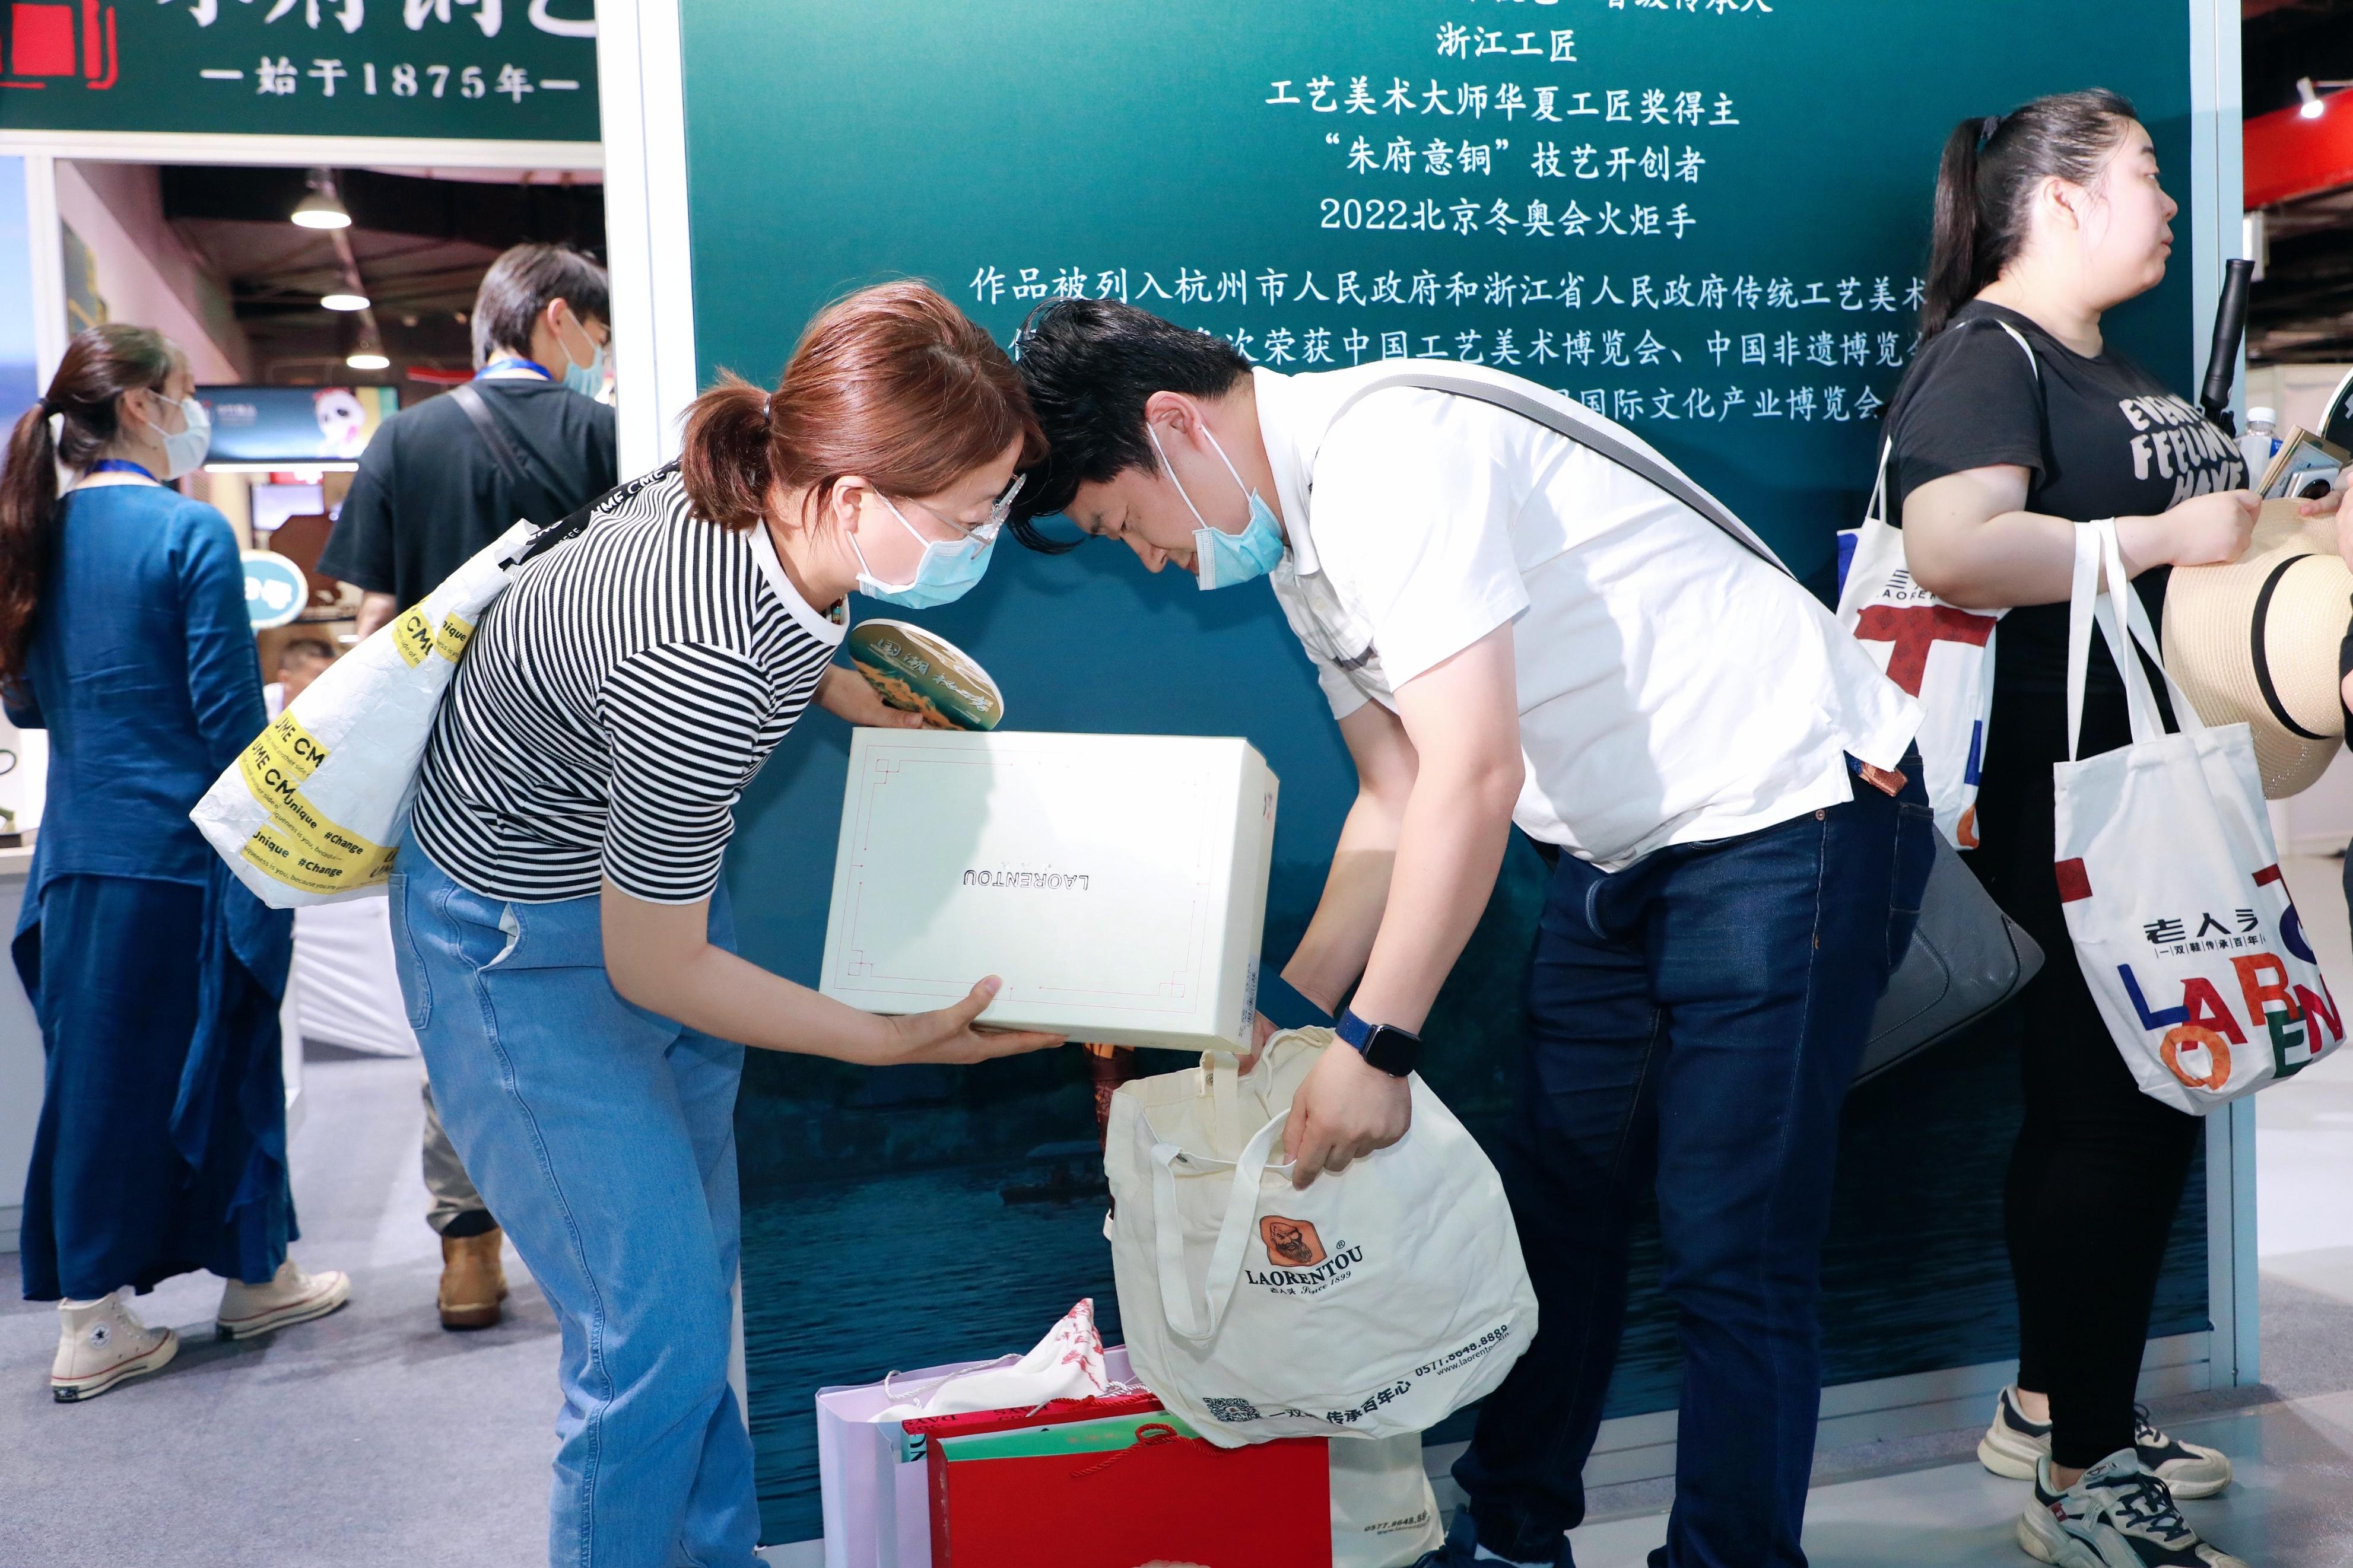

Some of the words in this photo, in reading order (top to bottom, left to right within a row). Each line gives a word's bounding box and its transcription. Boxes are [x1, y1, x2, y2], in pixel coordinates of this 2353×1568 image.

[1436, 21, 1577, 62] 浙江工匠
[1265, 75, 1740, 126] 工艺美术大师华夏工匠奖得主
[1320, 198, 1696, 239] 2022北京冬奥会火炬手
[969, 265, 1926, 312] 作品被列入杭州市人民政府和浙江省人民政府传统工艺美术
[1554, 385, 1884, 421] 国际文化产业博览会
[284, 794, 317, 829] Unique
[323, 831, 364, 855] #Change
[297, 858, 343, 878] #Change
[963, 869, 1090, 891] LAORENTOU
[1244, 1245, 1364, 1287] LAORENTOU
[1301, 1284, 1328, 1295] Since
[1330, 1270, 1352, 1286] 1899
